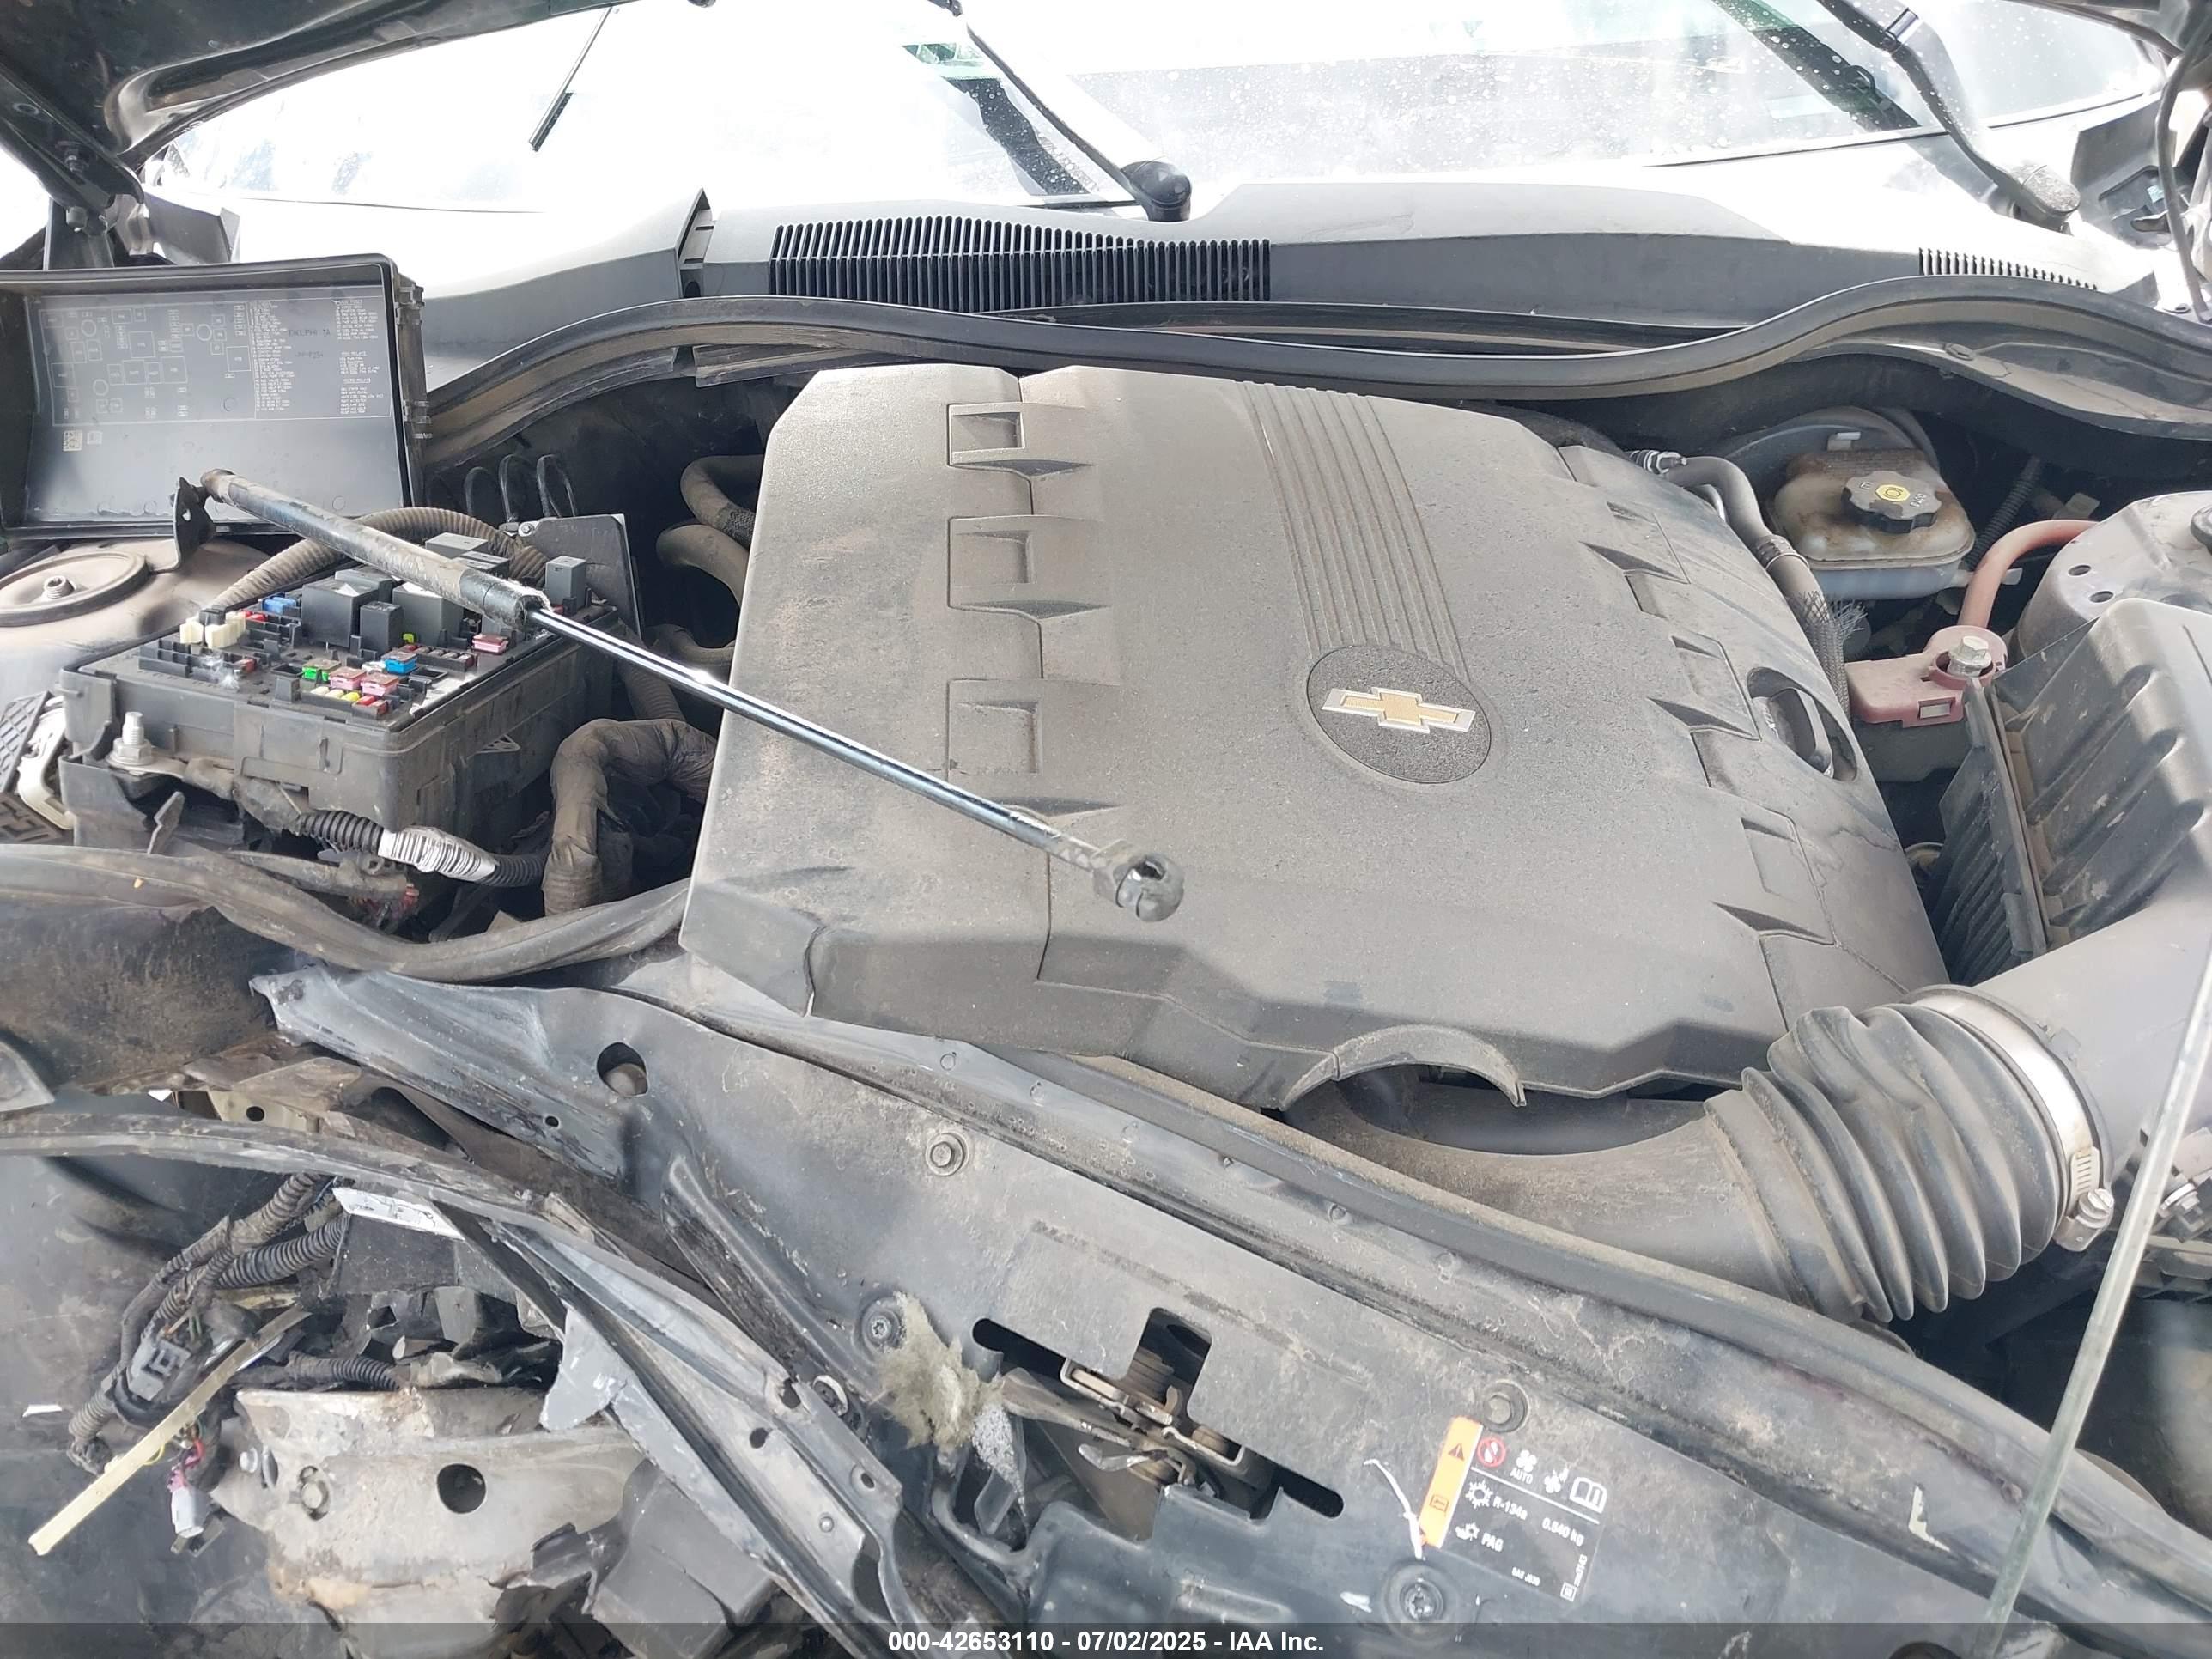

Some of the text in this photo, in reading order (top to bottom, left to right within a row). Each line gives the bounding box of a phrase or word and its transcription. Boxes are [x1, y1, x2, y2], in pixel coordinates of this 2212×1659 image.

[1510, 1468, 1533, 1485] AUTO
[1492, 1496, 1528, 1520] R-134a
[1481, 1532, 1504, 1553] PAG
